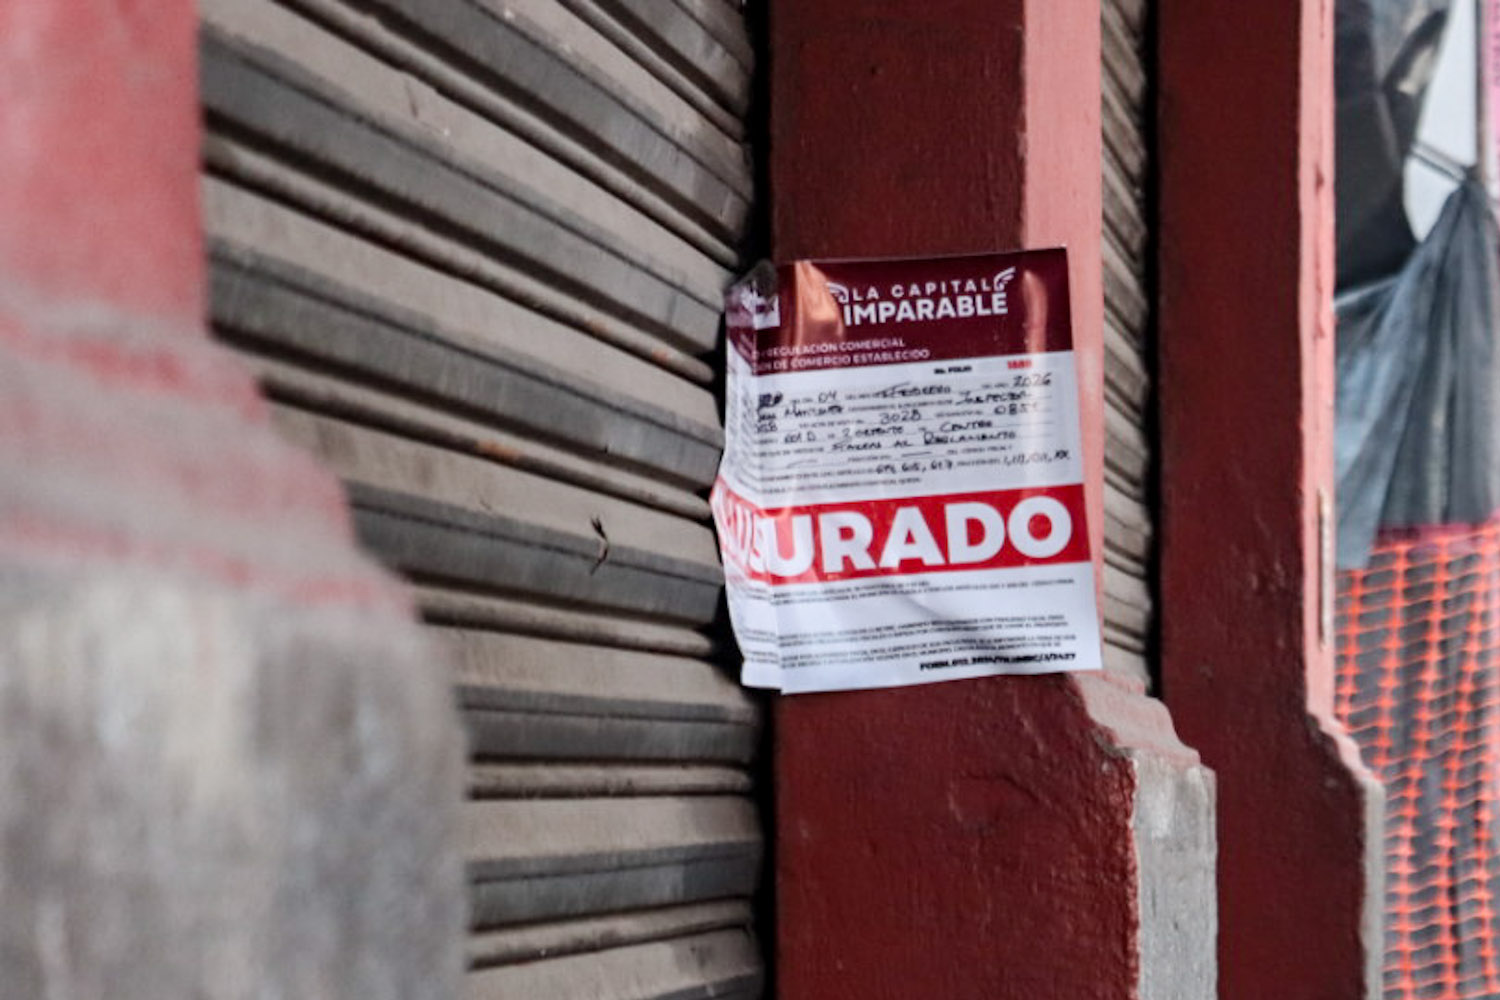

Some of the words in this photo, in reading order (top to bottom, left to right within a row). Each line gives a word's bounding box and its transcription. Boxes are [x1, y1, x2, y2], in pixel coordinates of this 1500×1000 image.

[852, 286, 880, 301] LA
[891, 277, 992, 299] CAPITAL
[844, 292, 1009, 327] IMPARABLE
[839, 338, 906, 353] COMERCIAL
[773, 359, 789, 371] DE
[790, 353, 851, 370] COMERCIO
[853, 348, 931, 365] ESTABLECIDO
[1013, 372, 1053, 388] 2026
[940, 420, 993, 433] CENTRO
